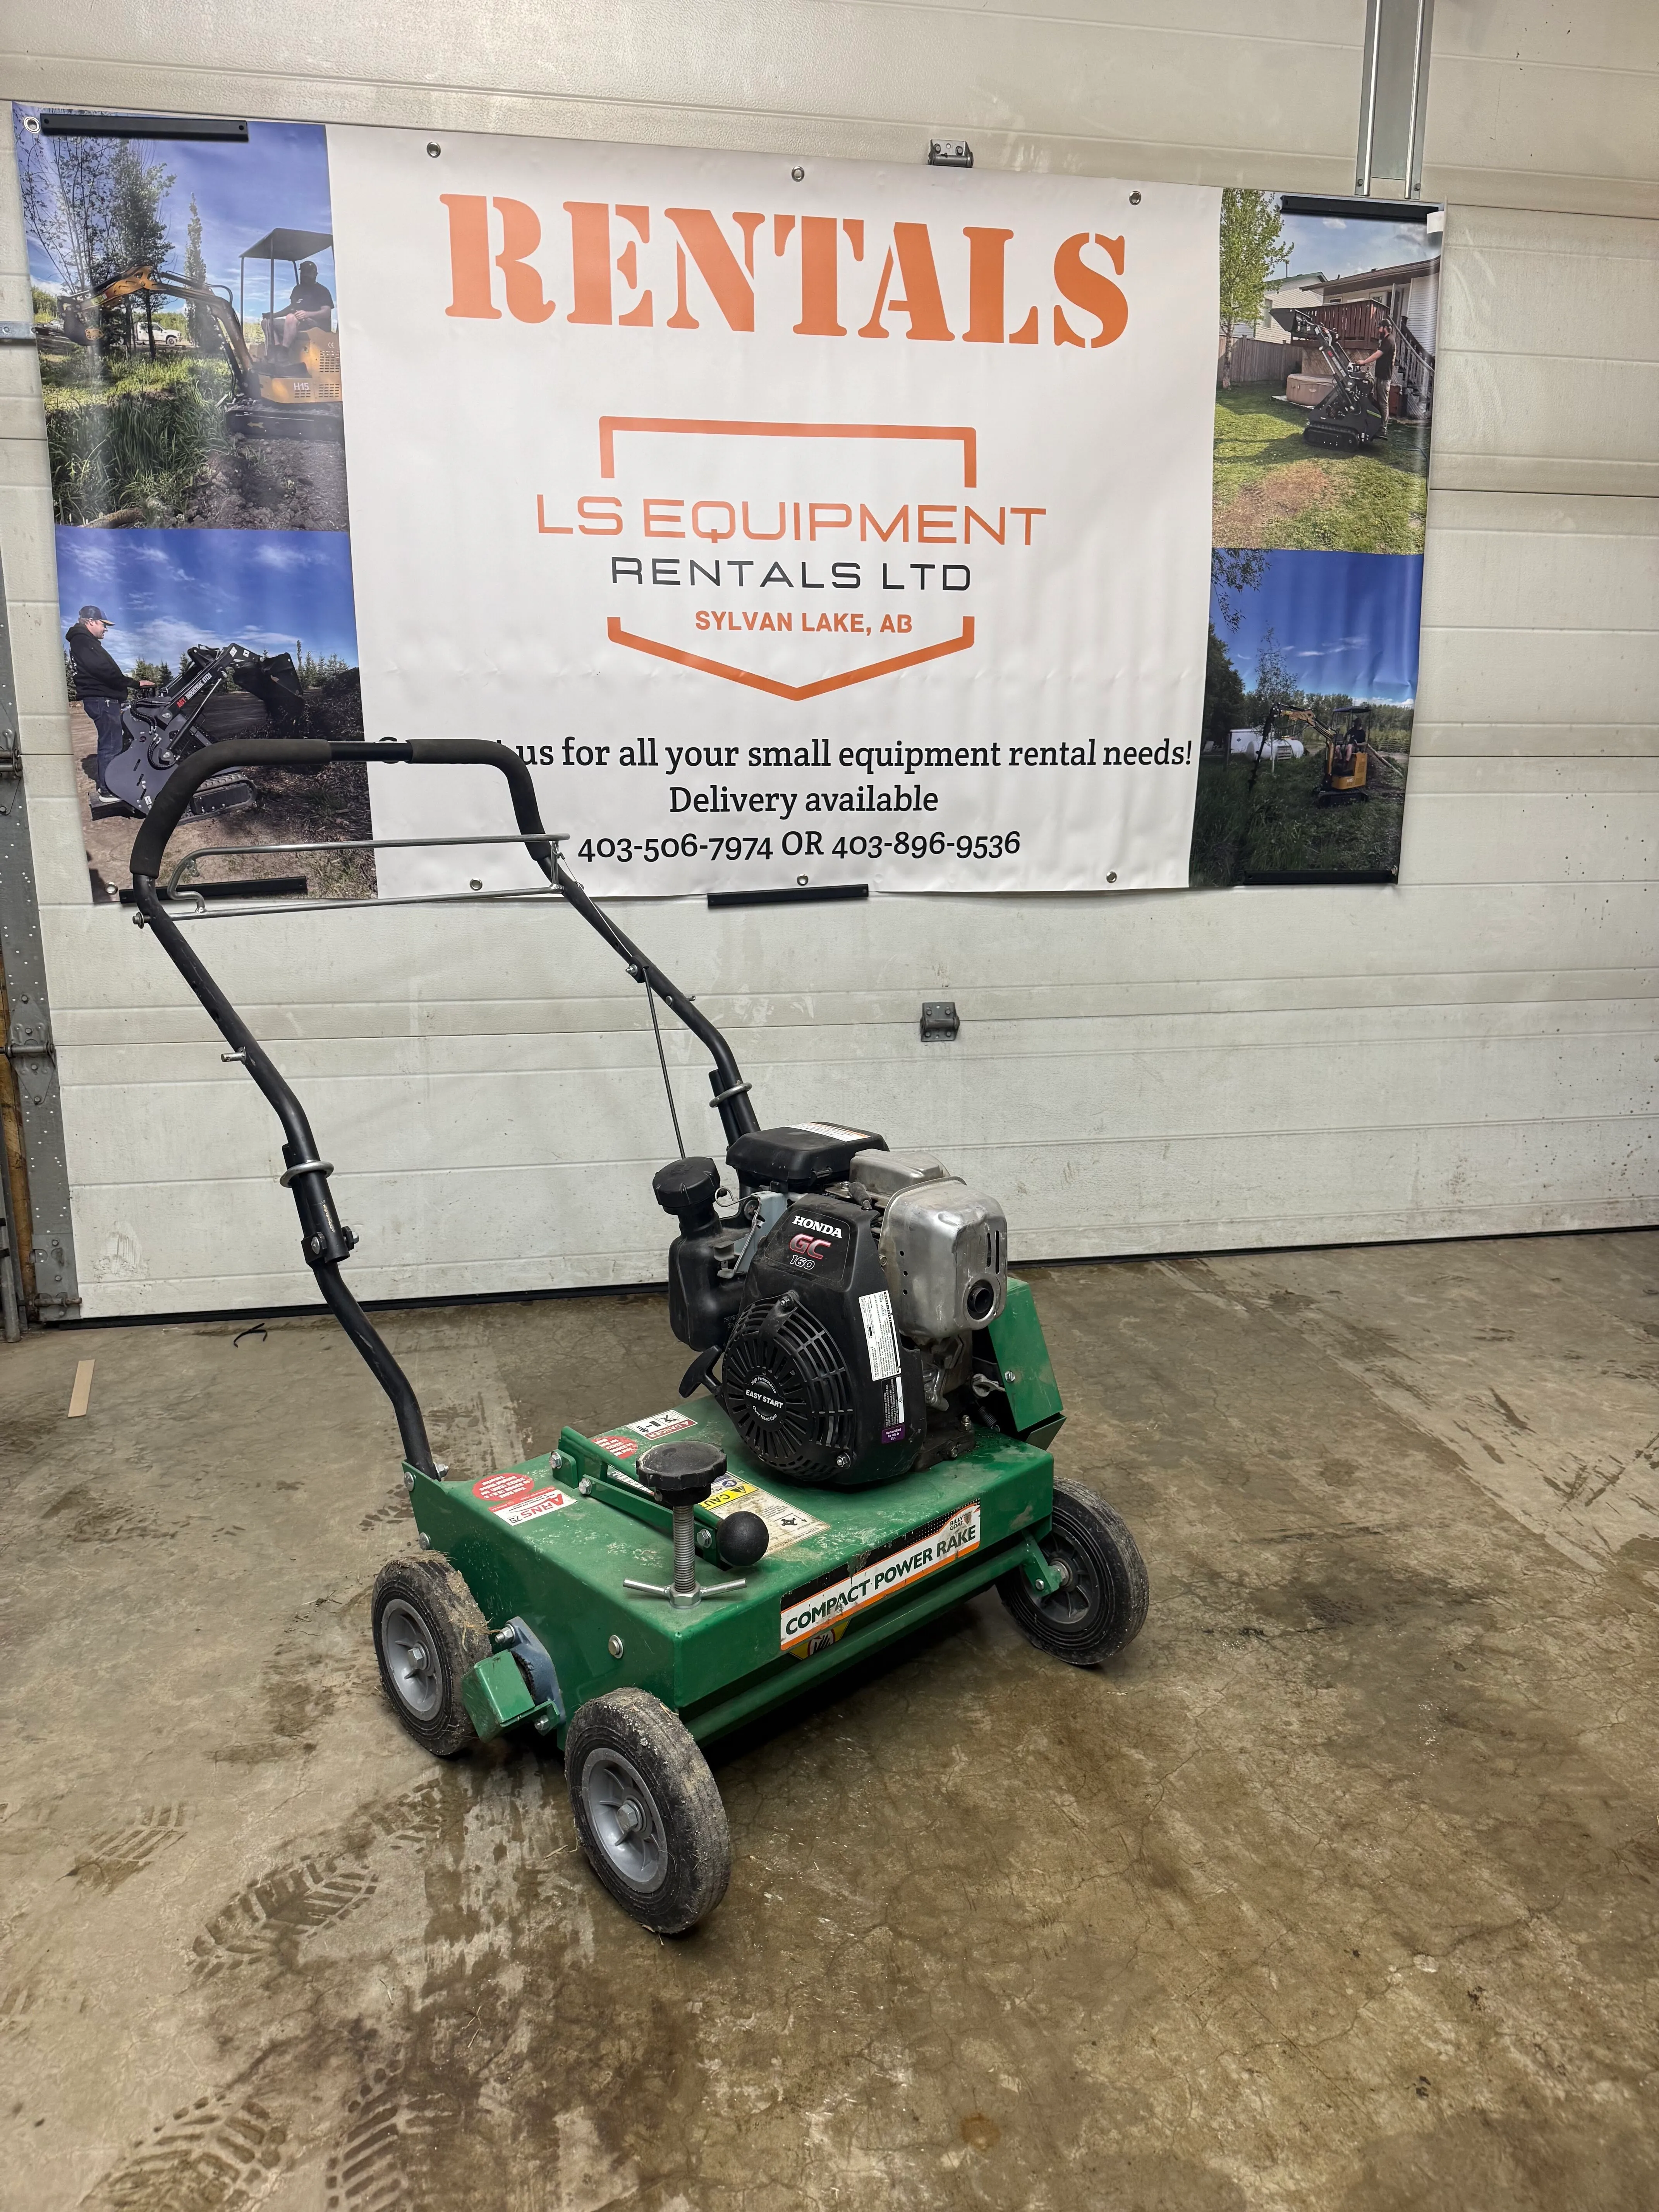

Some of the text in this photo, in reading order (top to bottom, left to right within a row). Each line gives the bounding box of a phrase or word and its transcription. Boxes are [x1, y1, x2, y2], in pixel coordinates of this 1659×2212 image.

[440, 193, 1129, 349] RENTALS
[294, 382, 309, 391] H15
[537, 495, 1046, 546] LS EQUIPMENT
[611, 557, 970, 591] RENTALS LTD
[696, 611, 912, 636] SYLVAN LAKE, AB
[516, 745, 554, 766] us
[562, 736, 610, 766] for
[619, 737, 658, 766] all
[665, 747, 739, 775] your
[748, 738, 831, 767] small
[839, 740, 1001, 775] equipment
[1008, 738, 1096, 766] rental
[1103, 738, 1192, 765] needs!
[669, 784, 938, 820] Delivery available
[578, 831, 1020, 862] 403-506-7974 OR 403-896-9536
[792, 1215, 842, 1238] HONDA
[789, 1233, 832, 1260] GC
[790, 1254, 815, 1270] 160
[745, 1389, 783, 1408] EASY START
[648, 1424, 682, 1437] DANGER
[950, 1516, 963, 1526] BILLY
[950, 1520, 963, 1530] GOAT
[786, 1524, 976, 1635] COMPACT POWER RAKE
